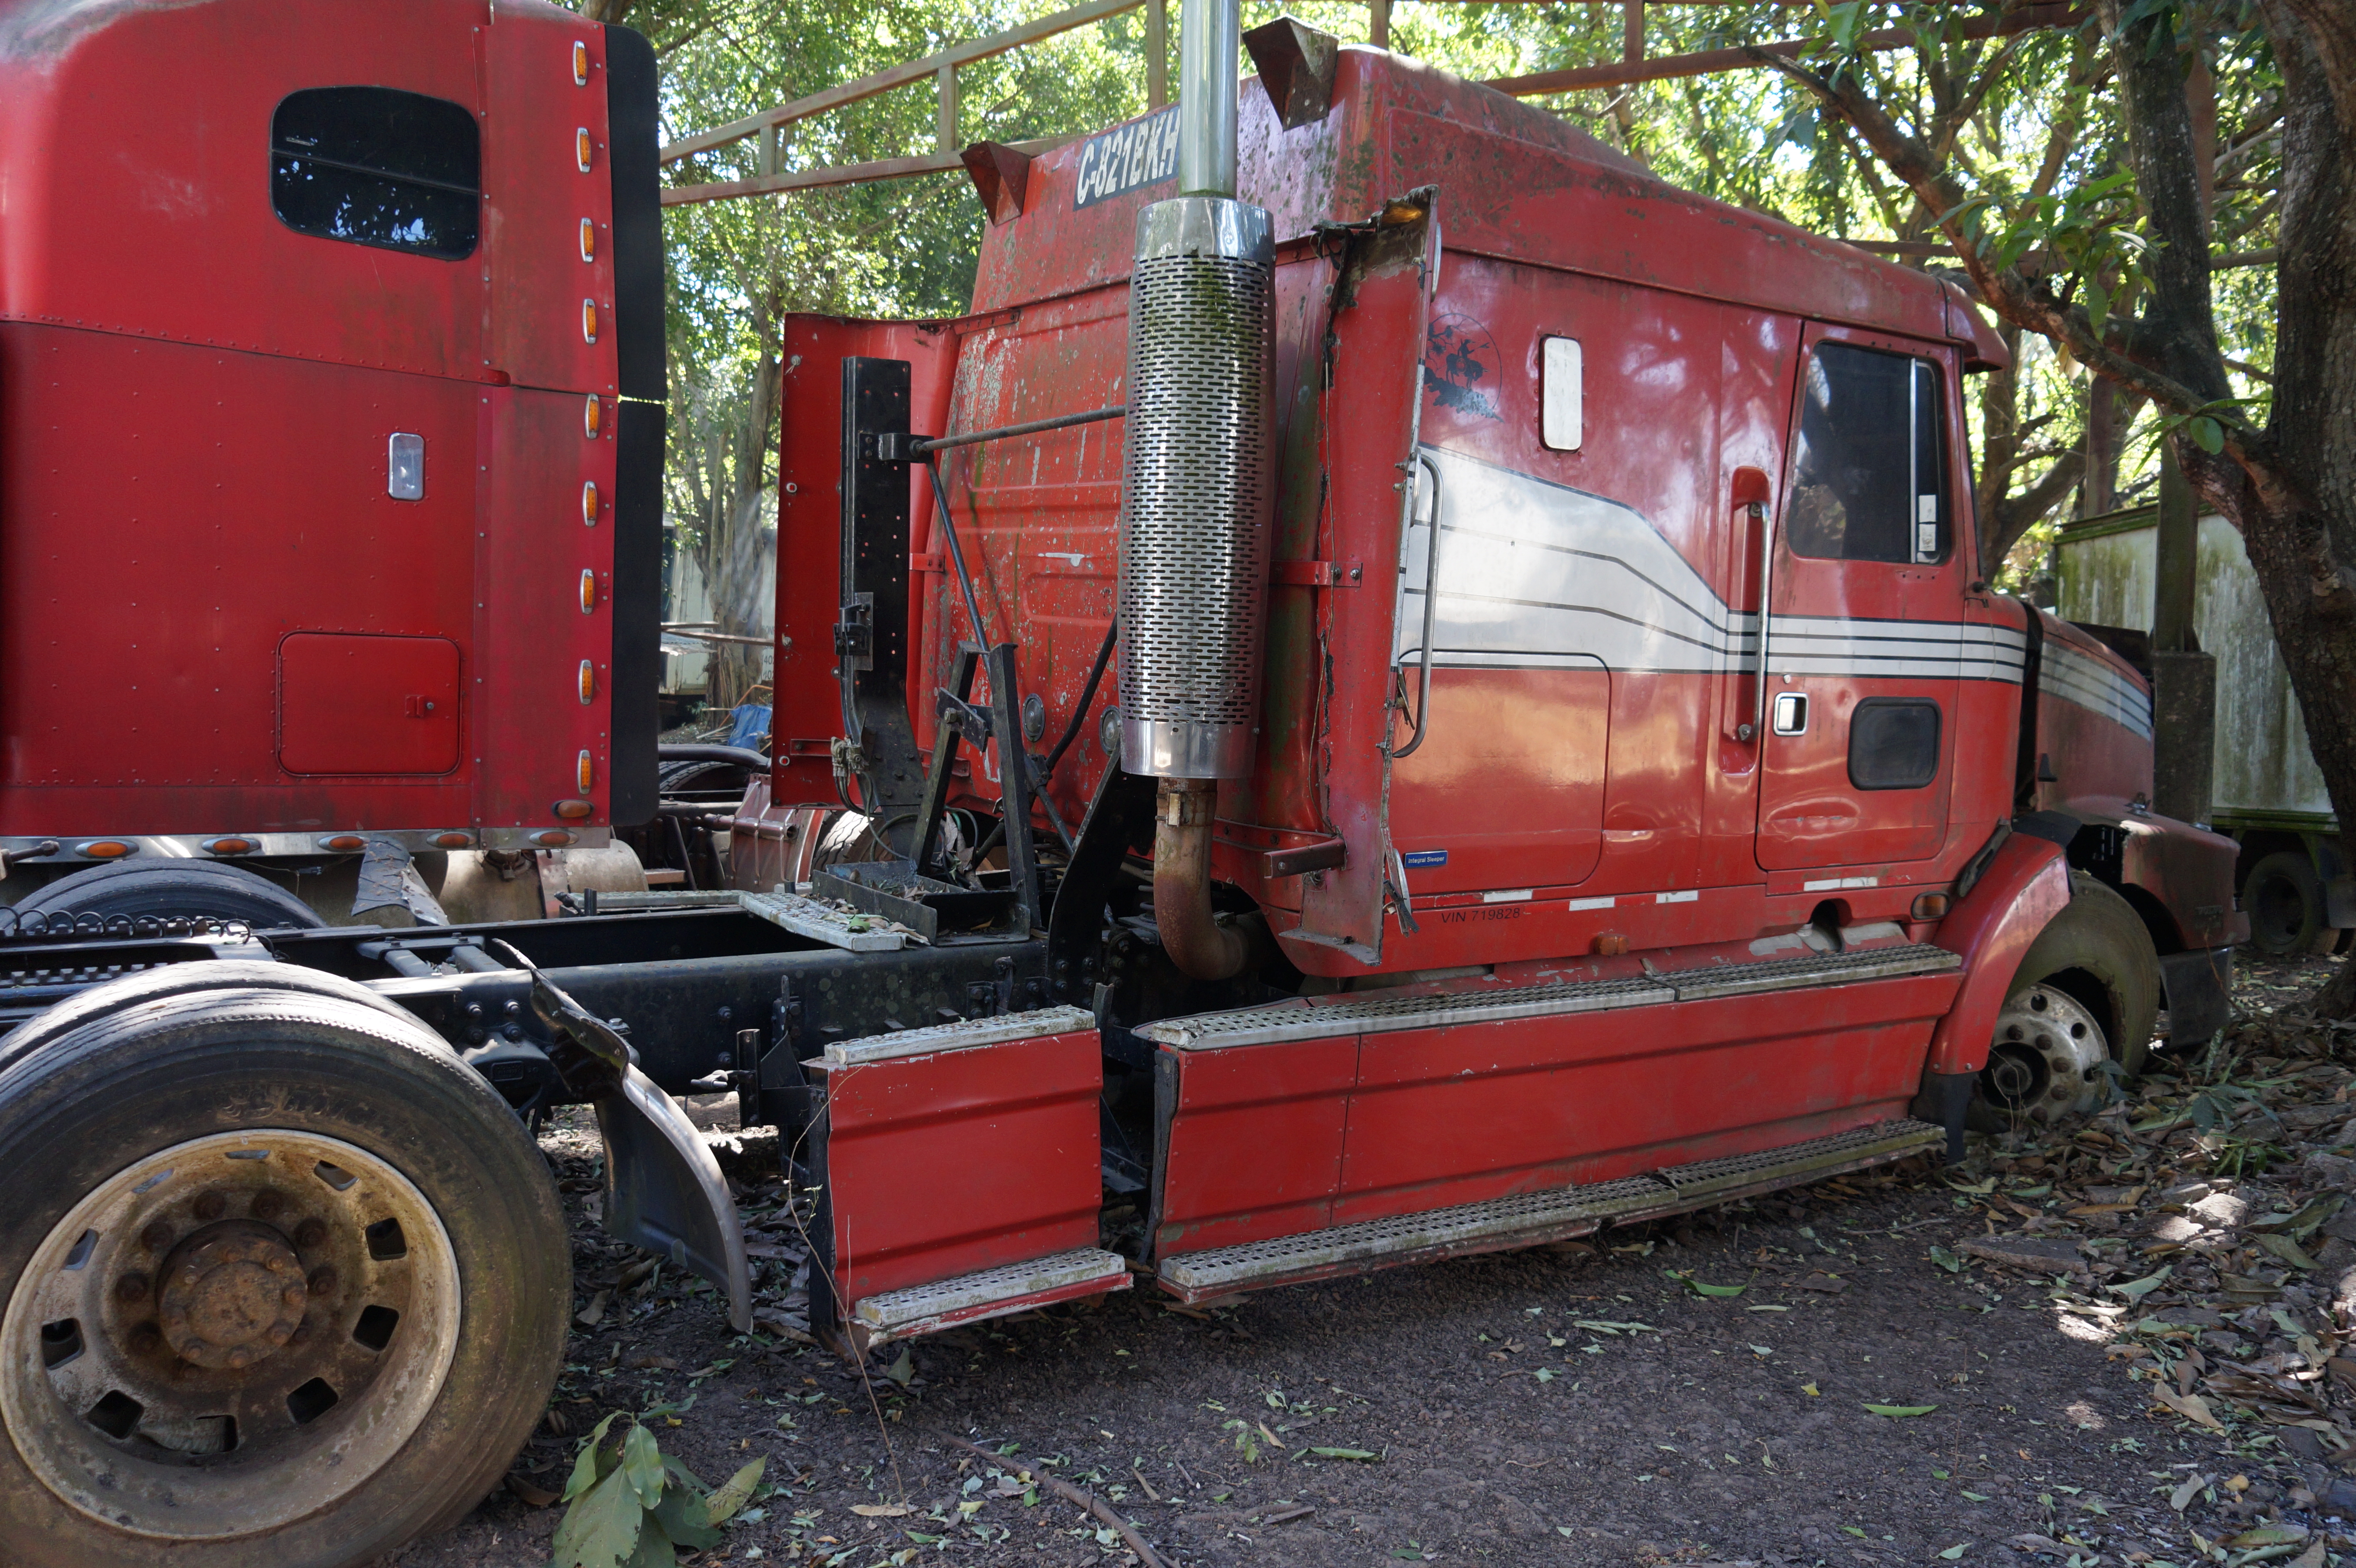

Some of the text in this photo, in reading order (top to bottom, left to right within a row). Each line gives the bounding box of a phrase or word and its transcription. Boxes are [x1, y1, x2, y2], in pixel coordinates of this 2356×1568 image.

[1077, 108, 1181, 204] C-821BKH
[1441, 908, 1520, 923] VIN 719828
